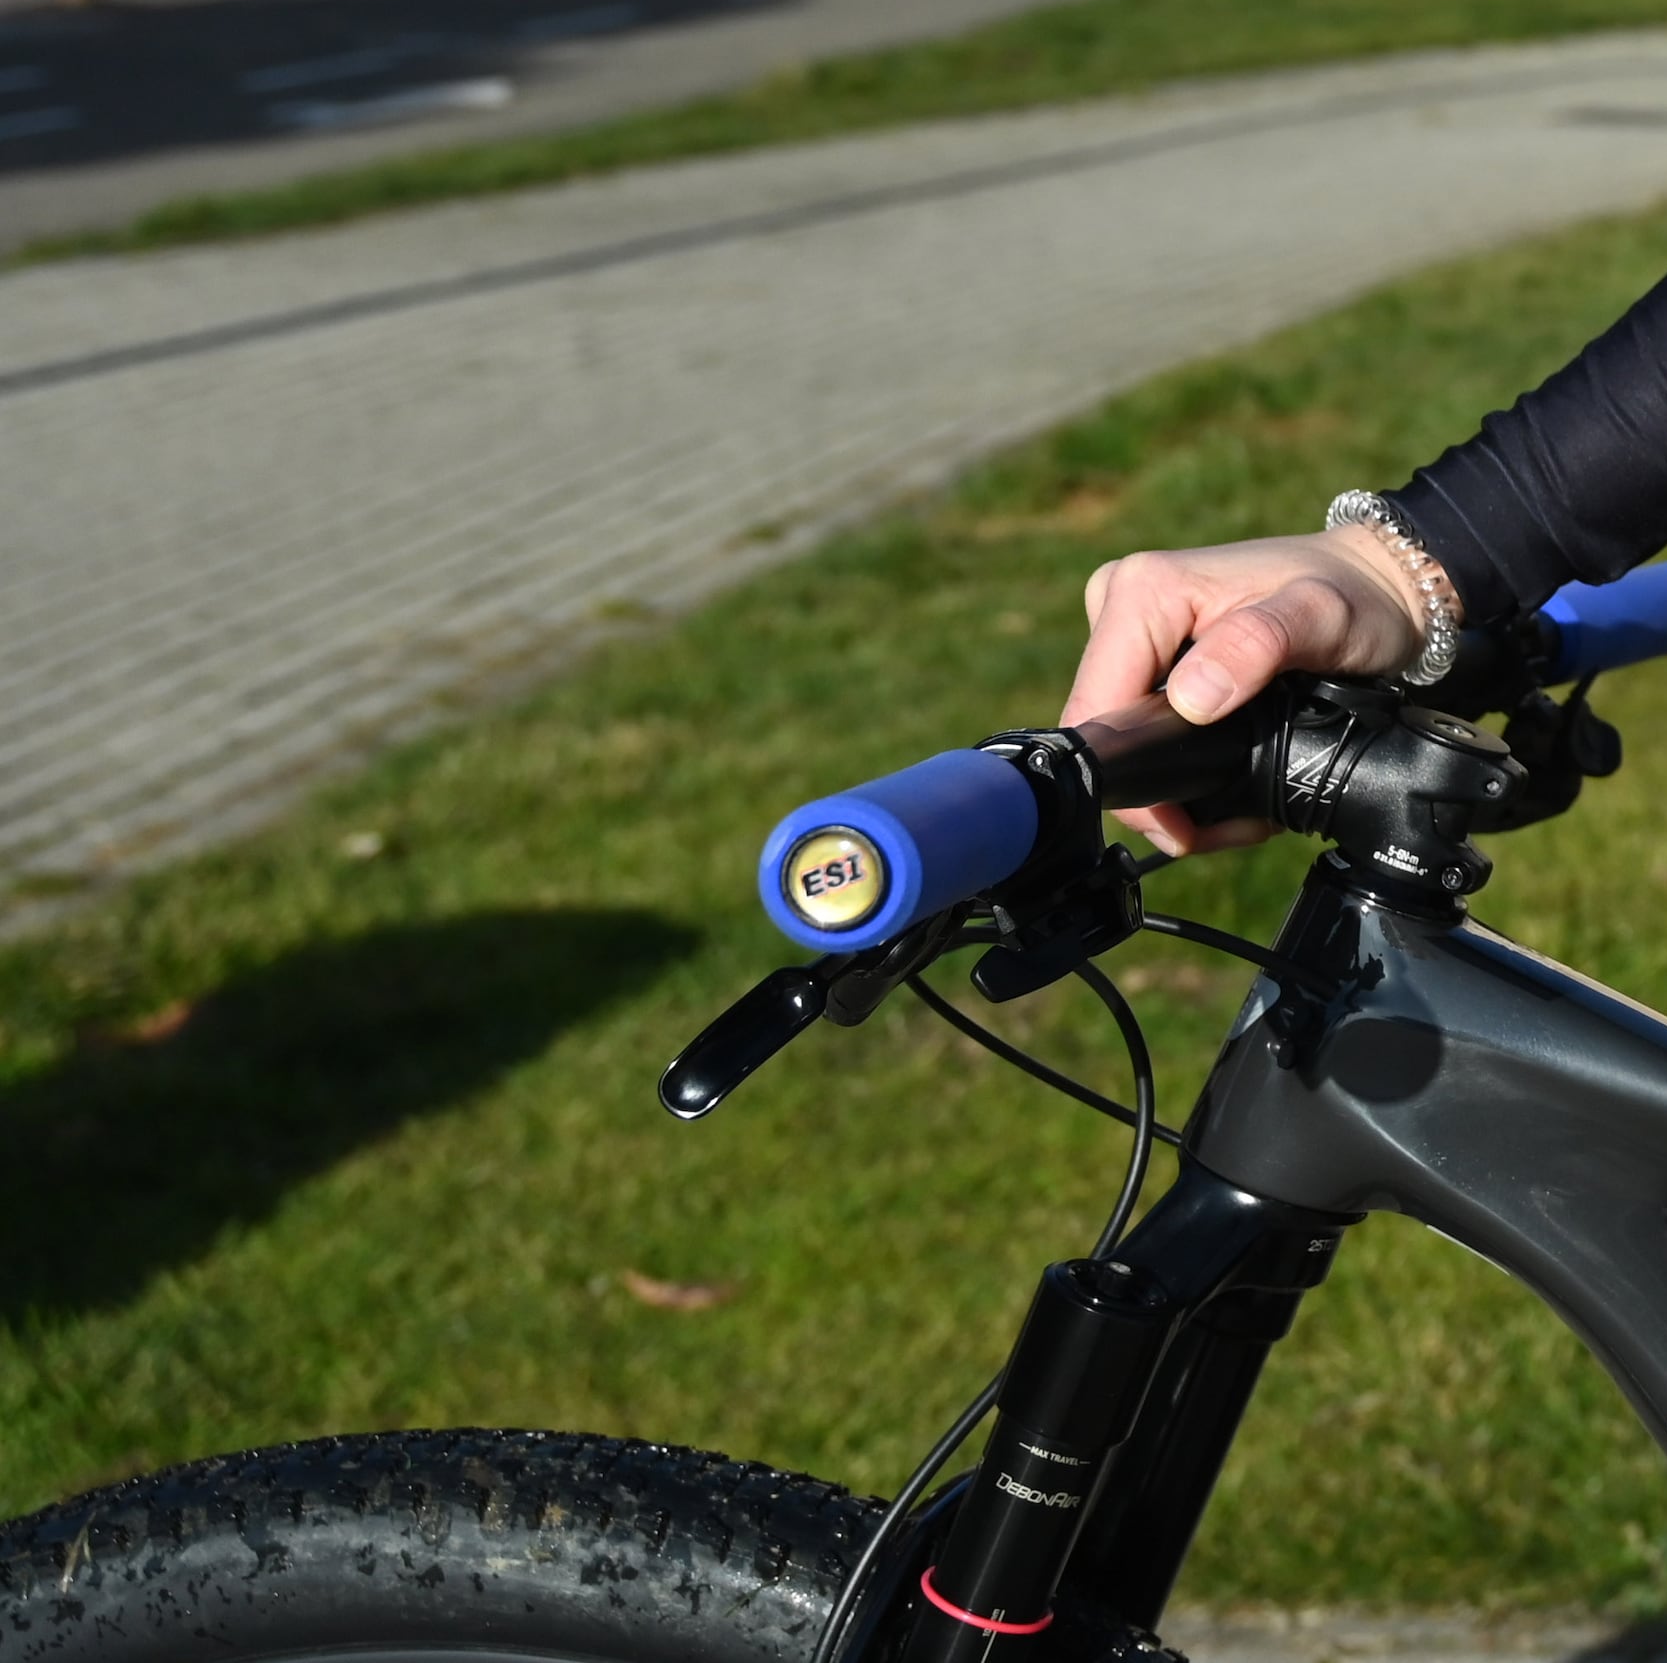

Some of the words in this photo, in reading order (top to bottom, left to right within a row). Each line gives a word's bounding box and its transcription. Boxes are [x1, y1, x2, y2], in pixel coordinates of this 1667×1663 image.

[801, 852, 864, 898] ESI
[1030, 1445, 1050, 1461] MAX
[1050, 1452, 1079, 1466] TRAVEL
